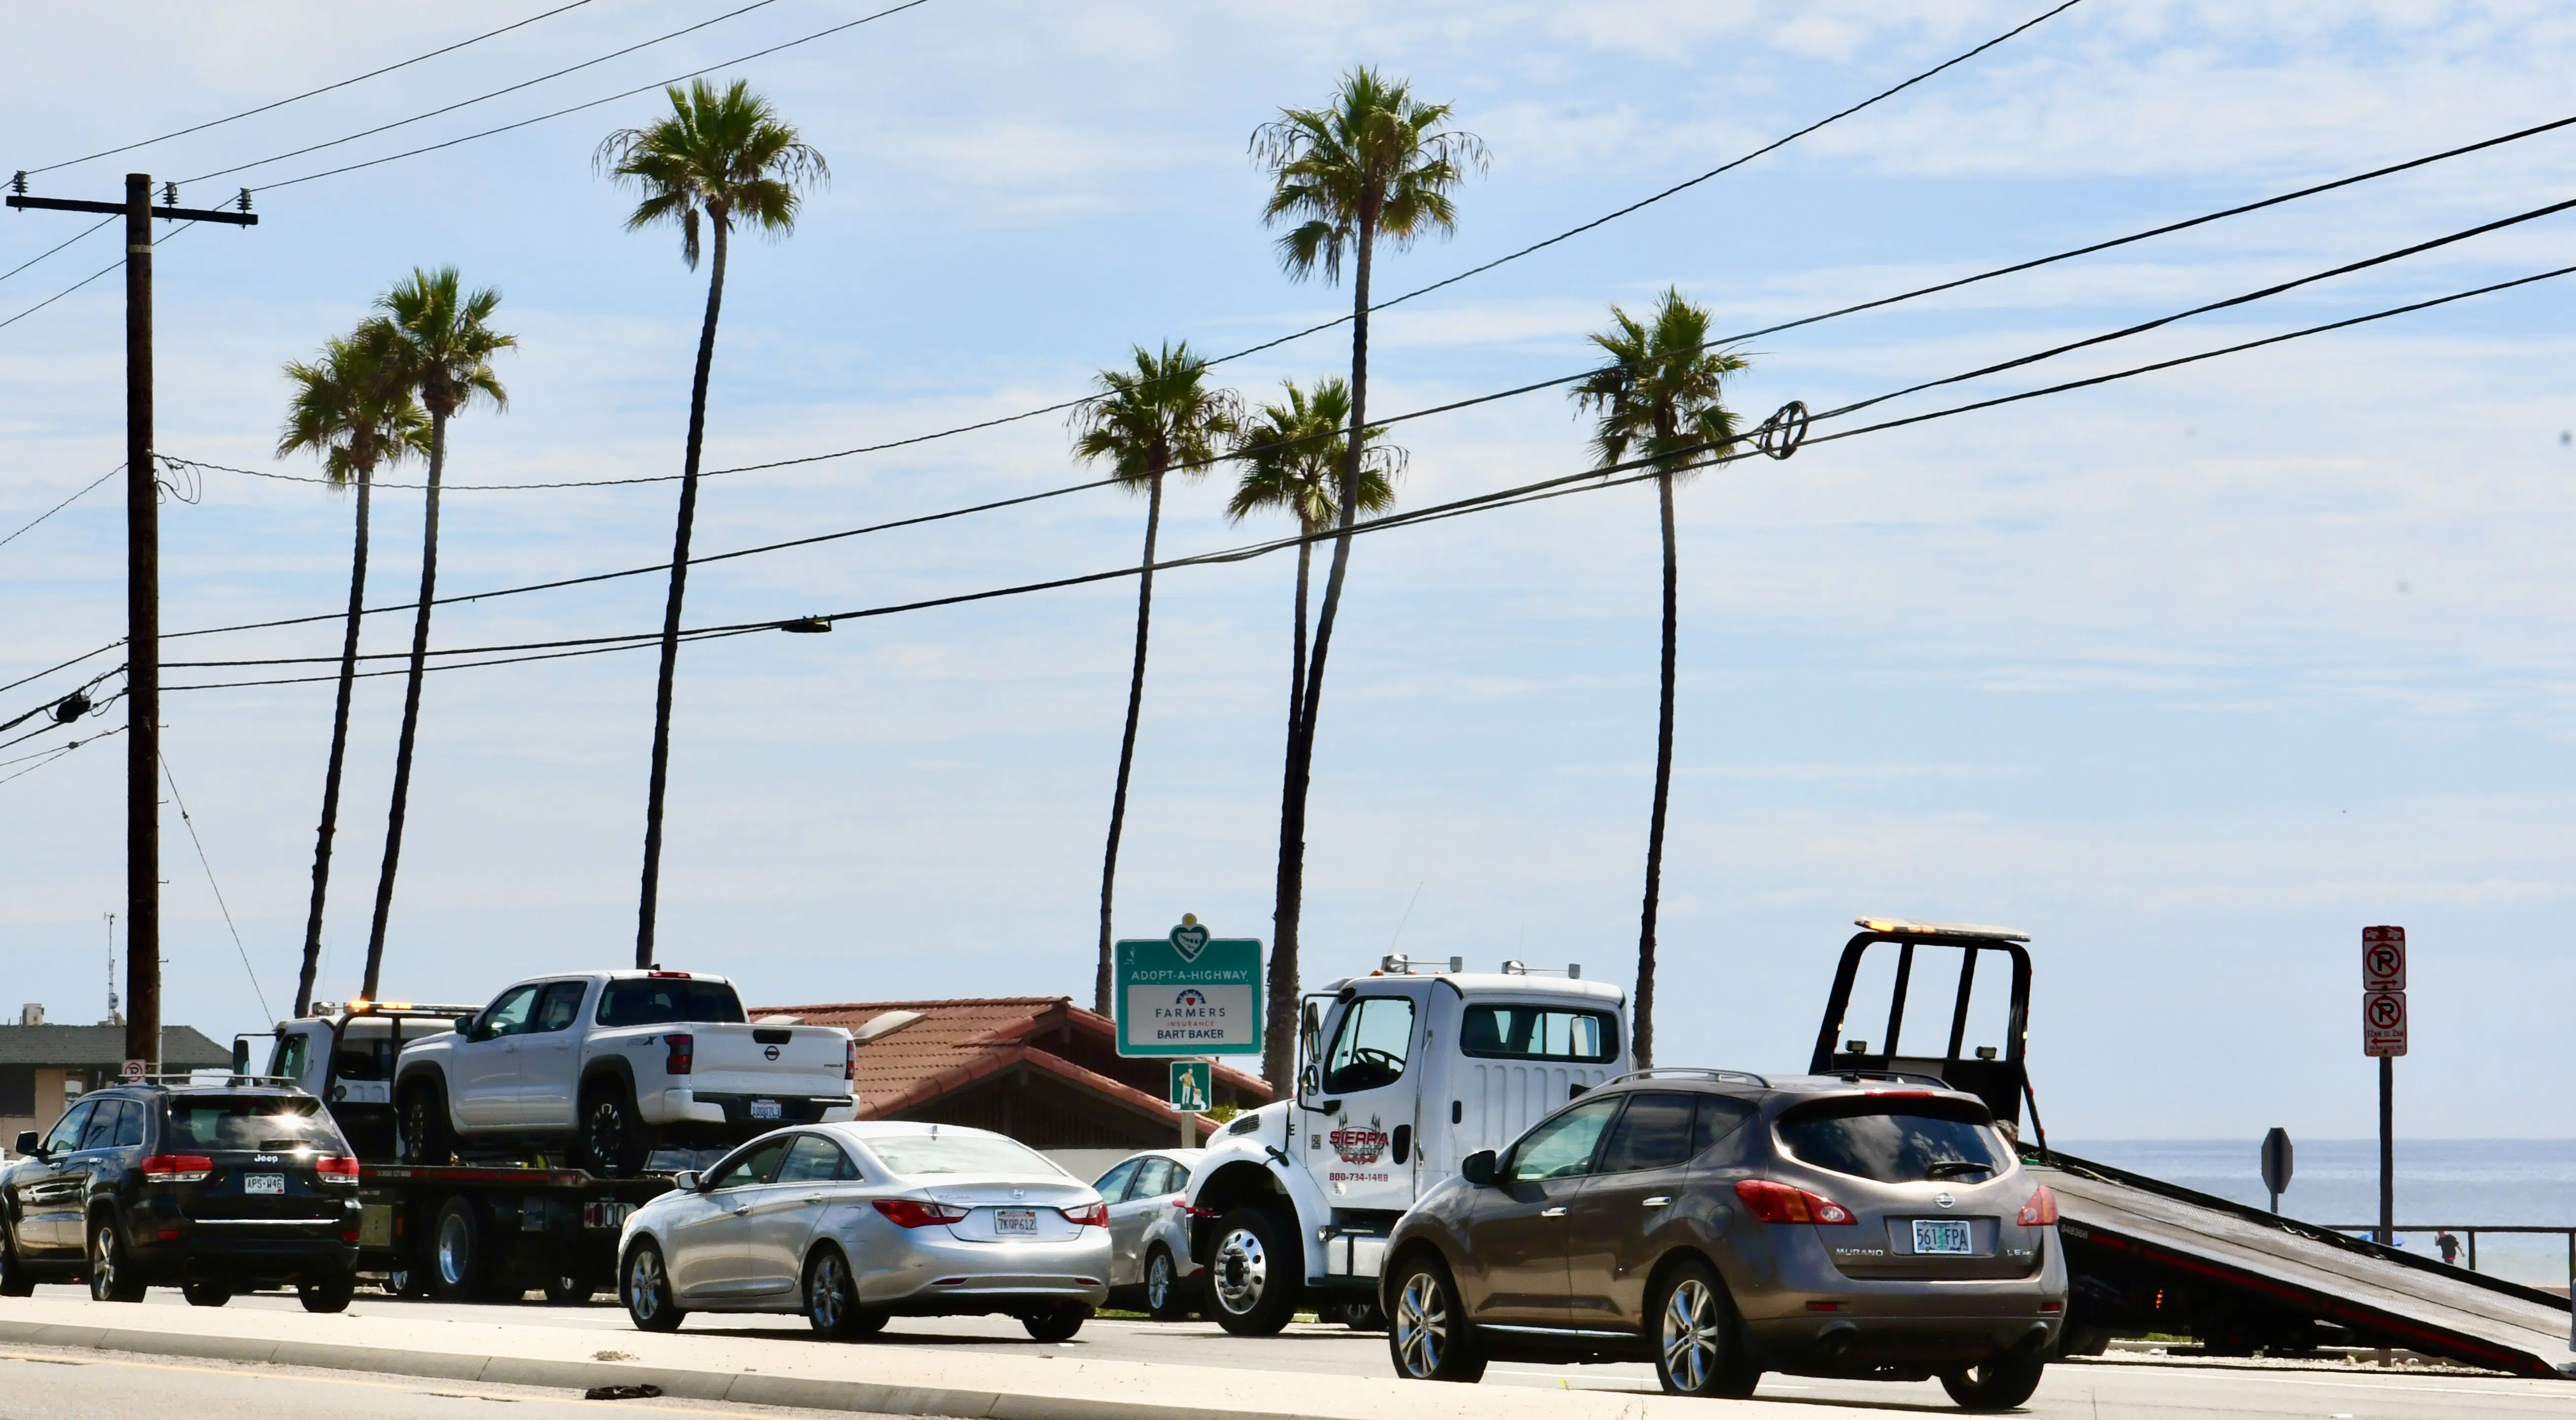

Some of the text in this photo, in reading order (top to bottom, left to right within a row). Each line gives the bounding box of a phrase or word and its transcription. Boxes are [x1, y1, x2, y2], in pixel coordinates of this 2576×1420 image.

[1131, 970, 1248, 980] ADOPT-A-HIGHWAY
[1156, 1008, 1226, 1018] FARMERS
[1157, 1029, 1224, 1039] BART BAKER
[1329, 1131, 1389, 1146] SIERRA
[254, 1154, 278, 1164] Jeep
[1329, 1172, 1388, 1182] 800-734-1488
[1917, 1228, 1968, 1246] 561 FPA
[1835, 1248, 1884, 1256] MURANO
